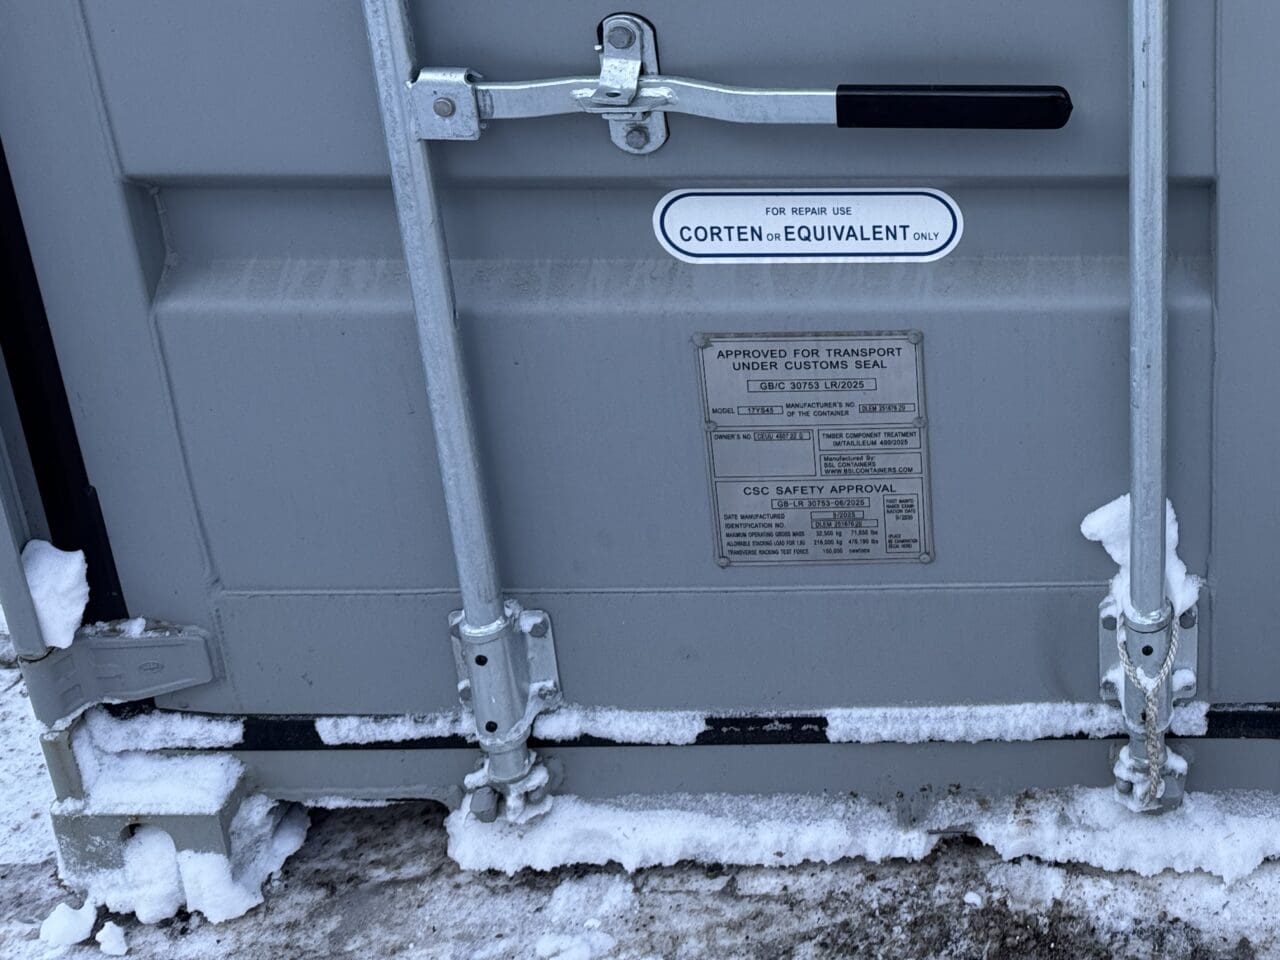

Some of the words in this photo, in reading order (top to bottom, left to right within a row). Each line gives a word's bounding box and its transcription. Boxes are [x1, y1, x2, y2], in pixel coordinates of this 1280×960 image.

[765, 207, 786, 216] FOR
[791, 207, 828, 216] REPAIR
[832, 206, 852, 216] USE
[679, 225, 763, 242] CORTEN
[766, 232, 781, 242] OR
[784, 224, 911, 242] EQUIVALENT
[913, 231, 940, 241] ONLY
[716, 349, 787, 359] APPROVED
[793, 349, 820, 358] FOR
[826, 347, 903, 358] TRANSPORT
[732, 361, 778, 371] UNDER
[784, 360, 849, 370] CUSTOMS
[854, 360, 888, 370] SEAL
[759, 381, 786, 391] GB/C
[790, 381, 820, 390] 30753
[824, 380, 865, 390] LR/2025
[711, 407, 736, 415] MODEL
[848, 431, 883, 439] COMPONENT
[743, 486, 770, 496] CSC
[776, 486, 825, 495] SAFETY
[830, 484, 896, 494] APPROVAL
